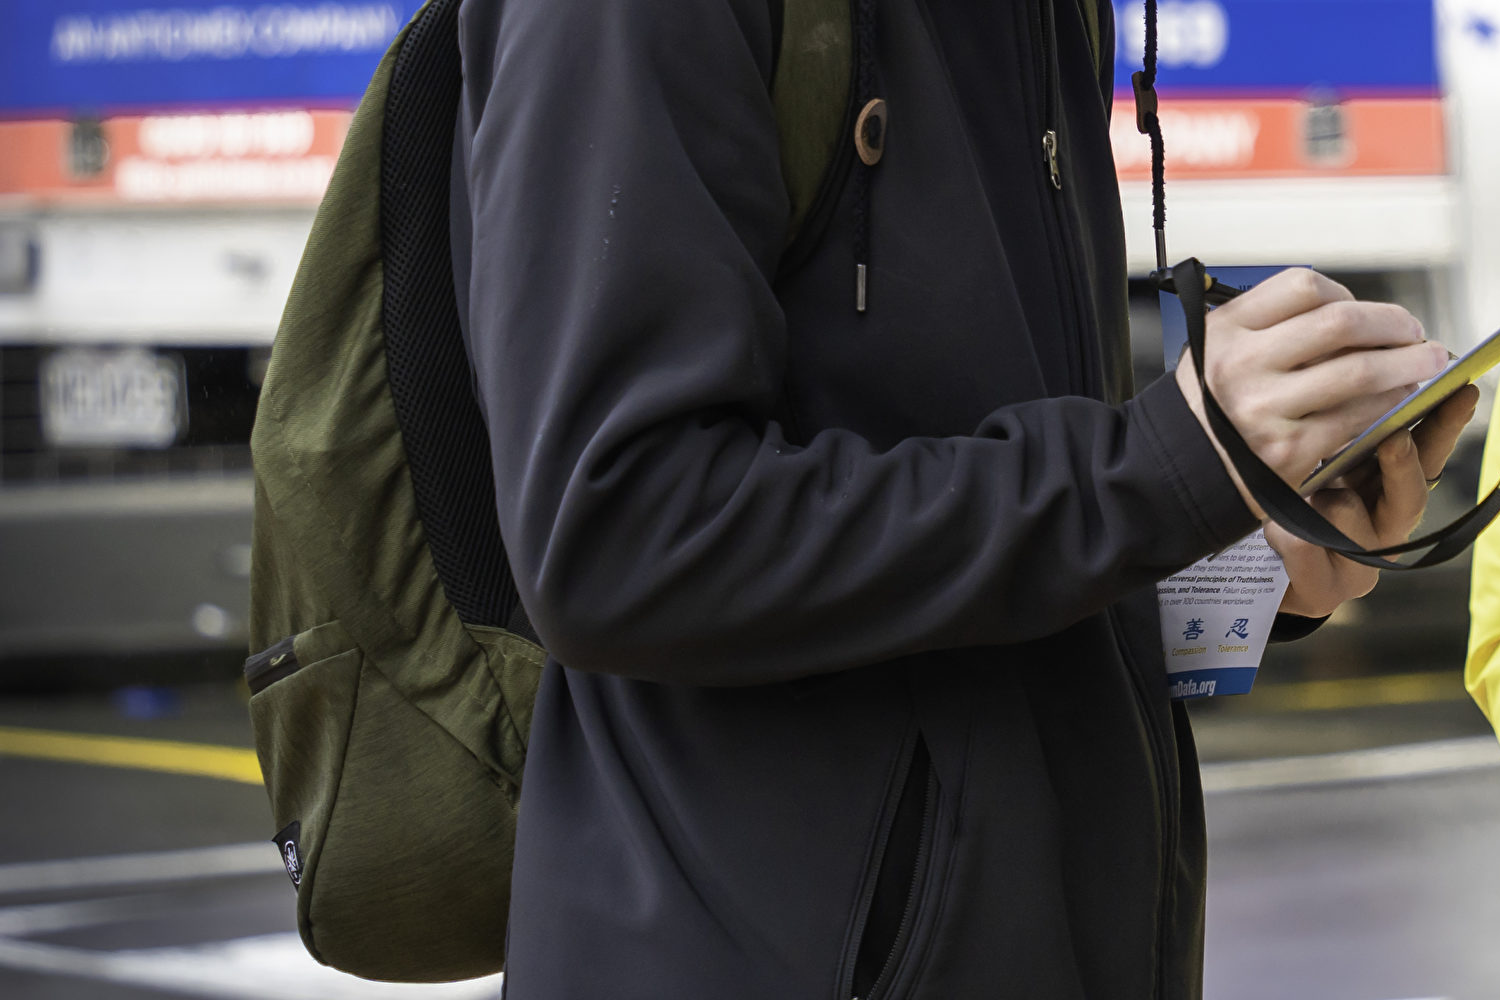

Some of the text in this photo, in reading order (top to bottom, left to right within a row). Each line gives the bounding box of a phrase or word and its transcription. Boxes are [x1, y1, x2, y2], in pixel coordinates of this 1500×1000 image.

[1240, 587, 1257, 595] Gong
[1182, 617, 1249, 640] 善 忍
[1172, 645, 1249, 656] Compassion Tolerance
